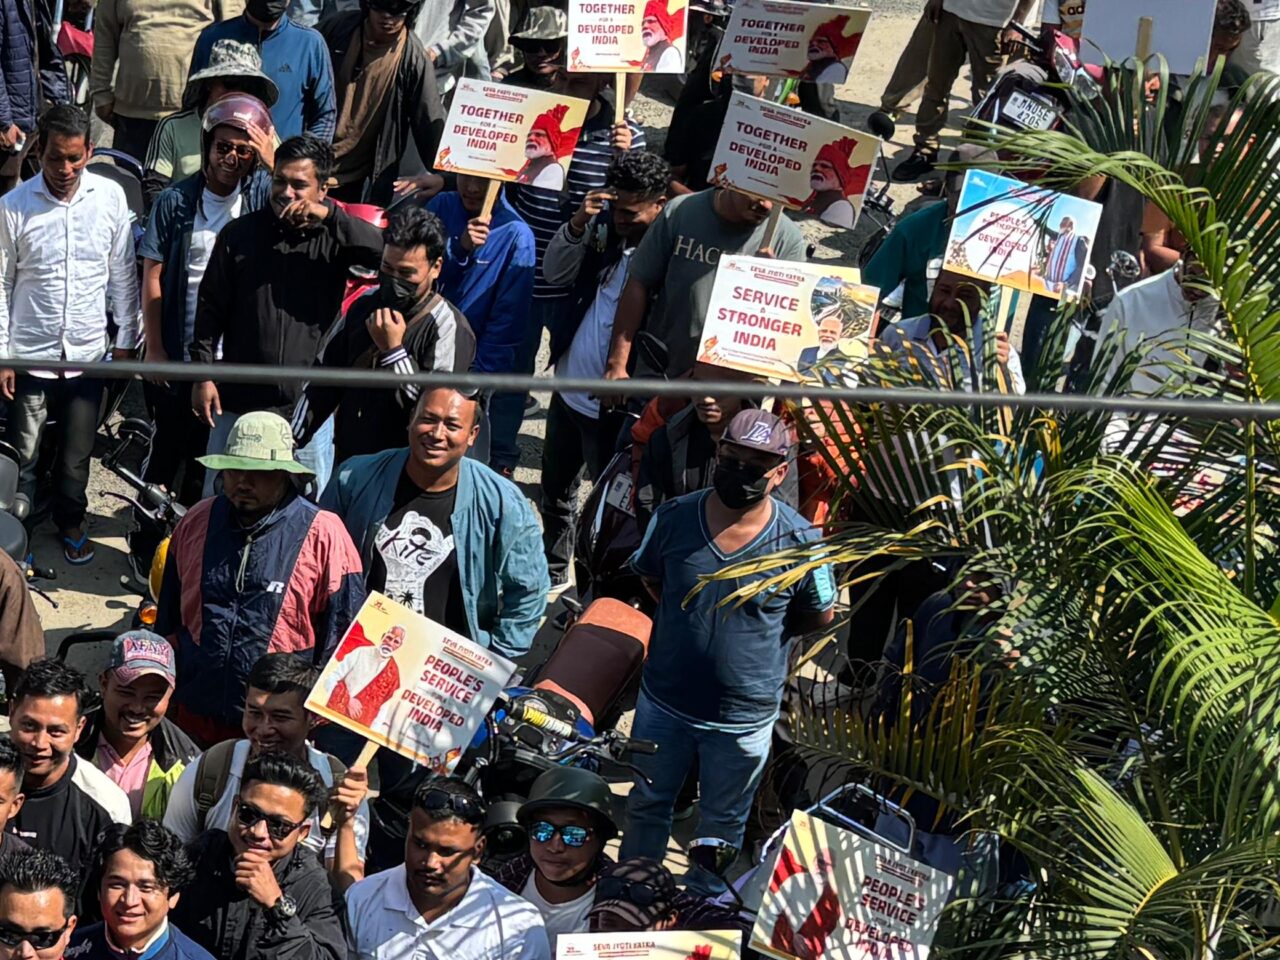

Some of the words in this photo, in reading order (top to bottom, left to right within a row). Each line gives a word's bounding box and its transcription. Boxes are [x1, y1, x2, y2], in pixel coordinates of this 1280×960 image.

[579, 3, 635, 14] TOGETHER
[577, 25, 634, 34] DEVELOPED
[741, 18, 805, 32] TOGETHER
[592, 36, 618, 45] INDIA
[734, 35, 800, 48] DEVELOPED
[748, 46, 779, 55] INDIA
[460, 104, 524, 124] TOGETHER
[453, 124, 518, 143] DEVELOPED
[467, 138, 497, 151] INDIA
[737, 121, 808, 151] TOGETHER
[729, 142, 801, 171] DEVELOPED
[745, 158, 779, 176] INDIA
[732, 286, 799, 311] SERVICE
[717, 308, 802, 336] STRONGER
[733, 331, 777, 350] INDIA
[425, 655, 484, 692] PEOPLE'S
[421, 670, 474, 704] SERVICE
[401, 689, 464, 727] DEVELOPED
[408, 707, 443, 732] INDIA
[863, 875, 926, 911] PEOPLE'S
[860, 894, 918, 925] SERVICE
[846, 918, 913, 952] DEVELOPED
